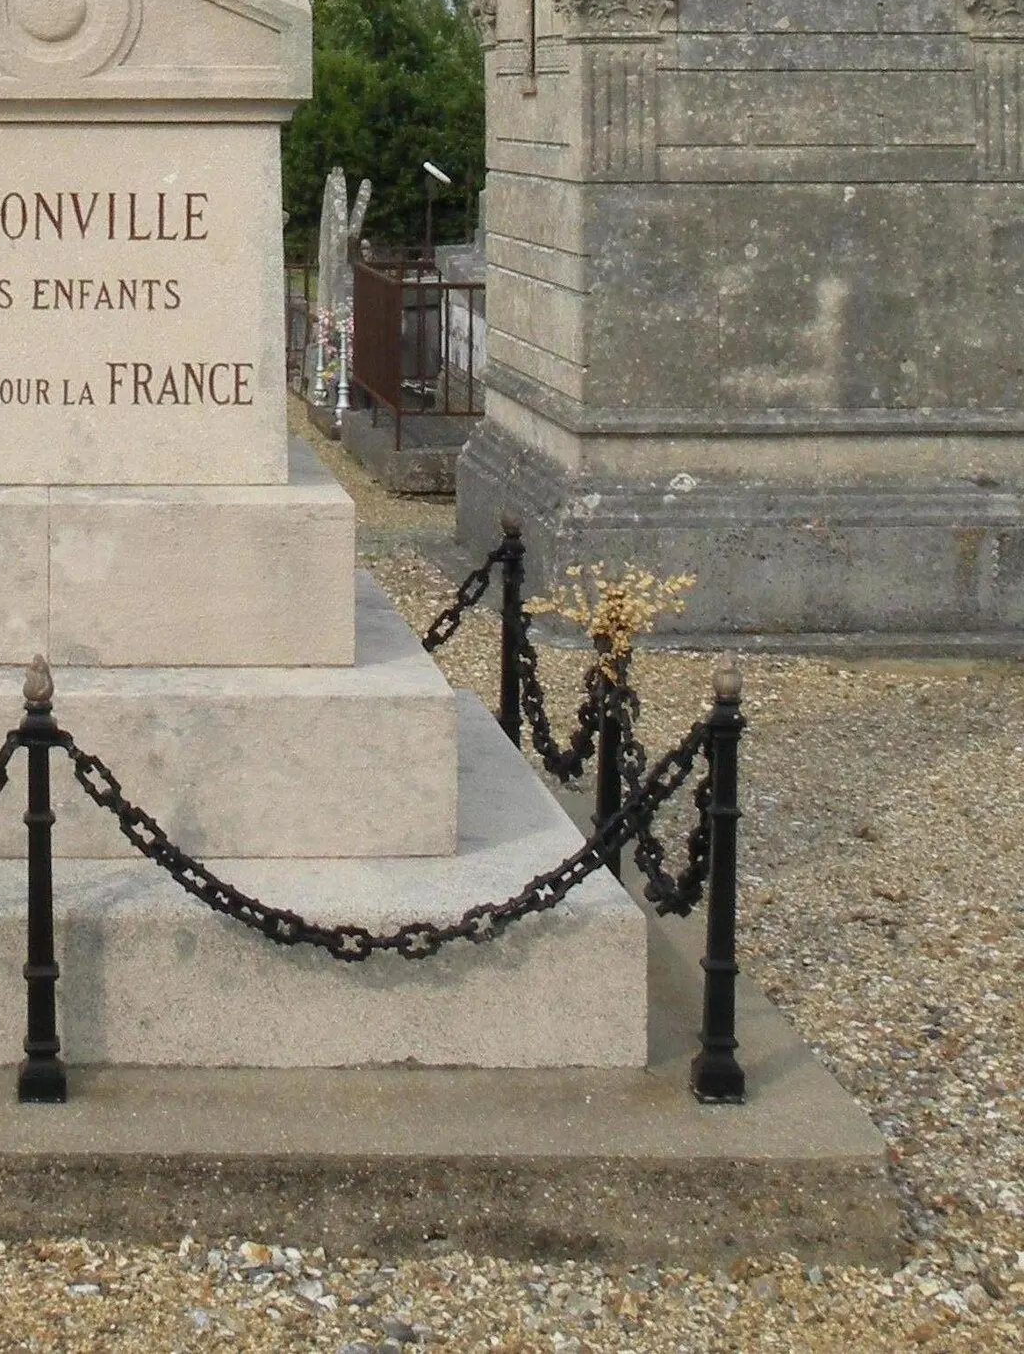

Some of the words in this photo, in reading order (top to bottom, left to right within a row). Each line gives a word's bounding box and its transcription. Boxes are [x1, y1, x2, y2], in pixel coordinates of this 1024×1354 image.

[32, 279, 182, 310] ENFANTS
[63, 378, 95, 406] LA
[106, 362, 254, 406] FRANCE
